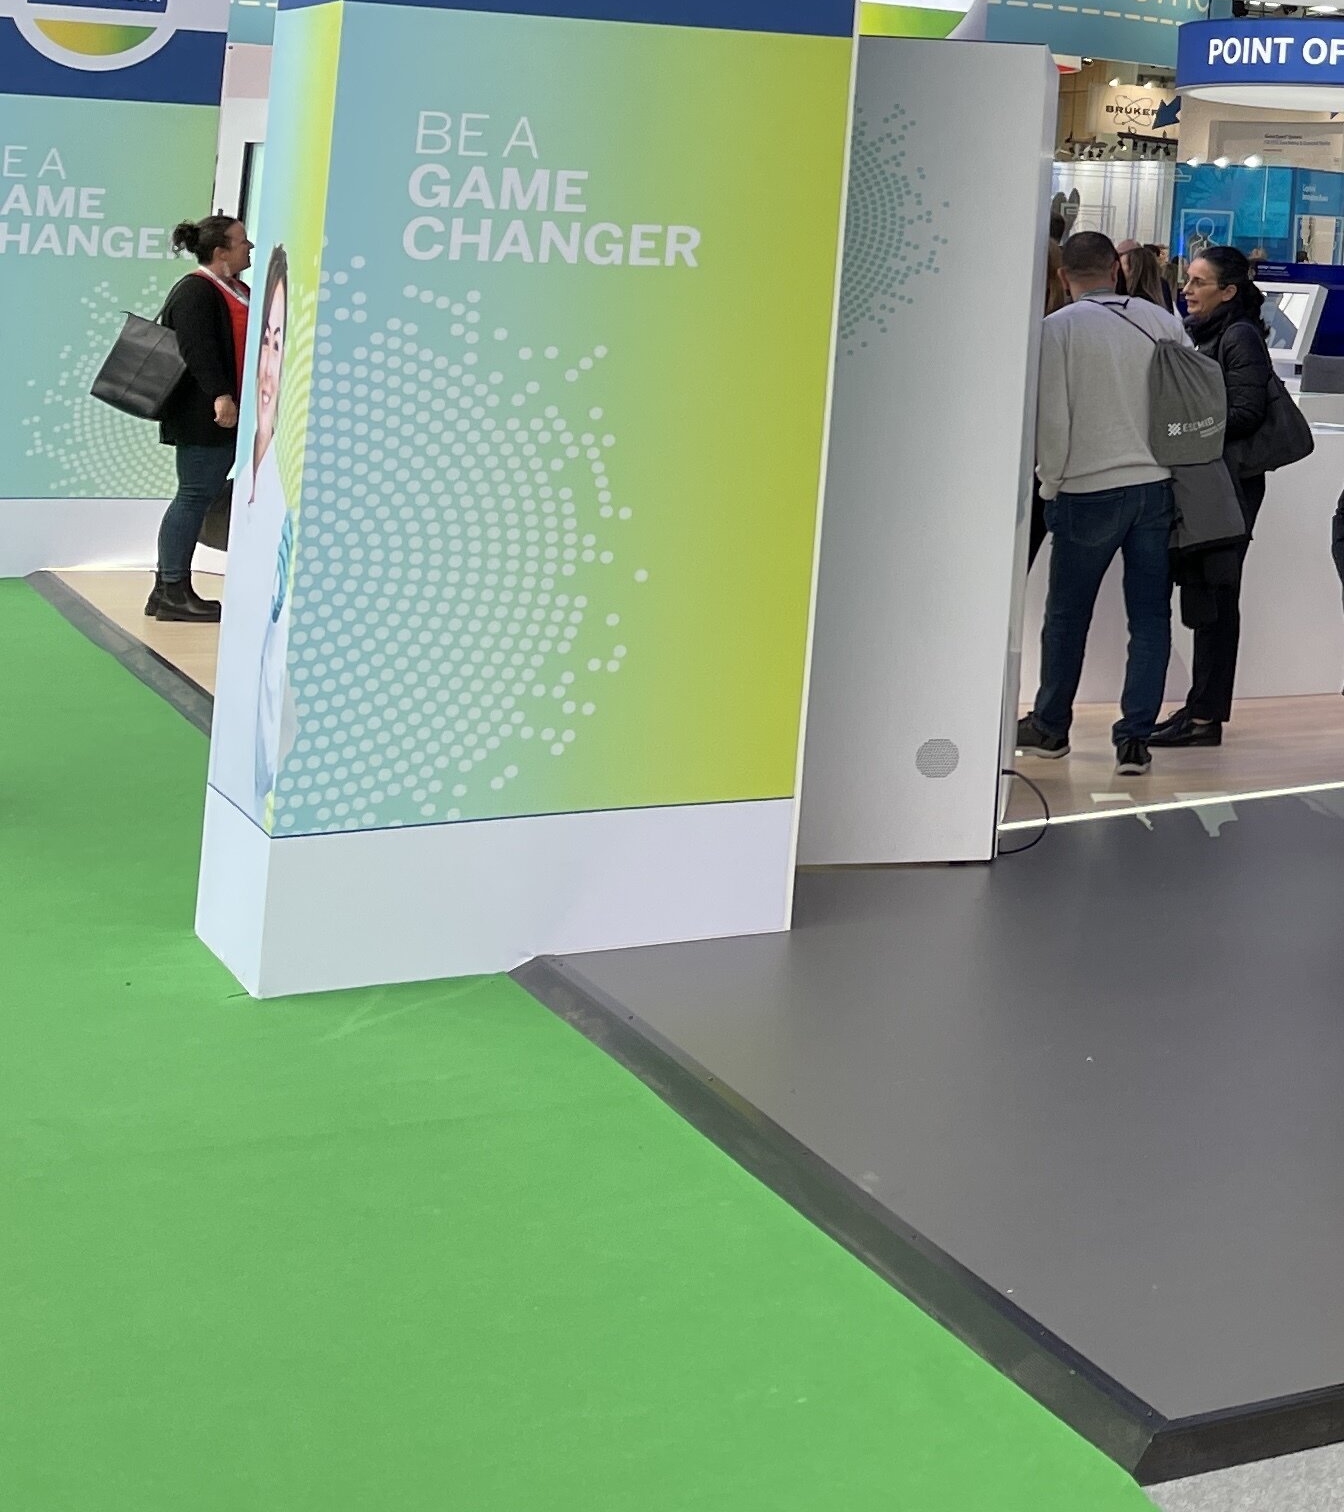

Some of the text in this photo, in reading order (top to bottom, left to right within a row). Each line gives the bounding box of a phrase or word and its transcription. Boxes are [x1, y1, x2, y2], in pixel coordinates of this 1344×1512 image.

[1208, 37, 1294, 65] POINT
[416, 110, 538, 159] BE A
[37, 147, 67, 180] A
[408, 163, 589, 213] GAME
[402, 215, 701, 268] CHANGER
